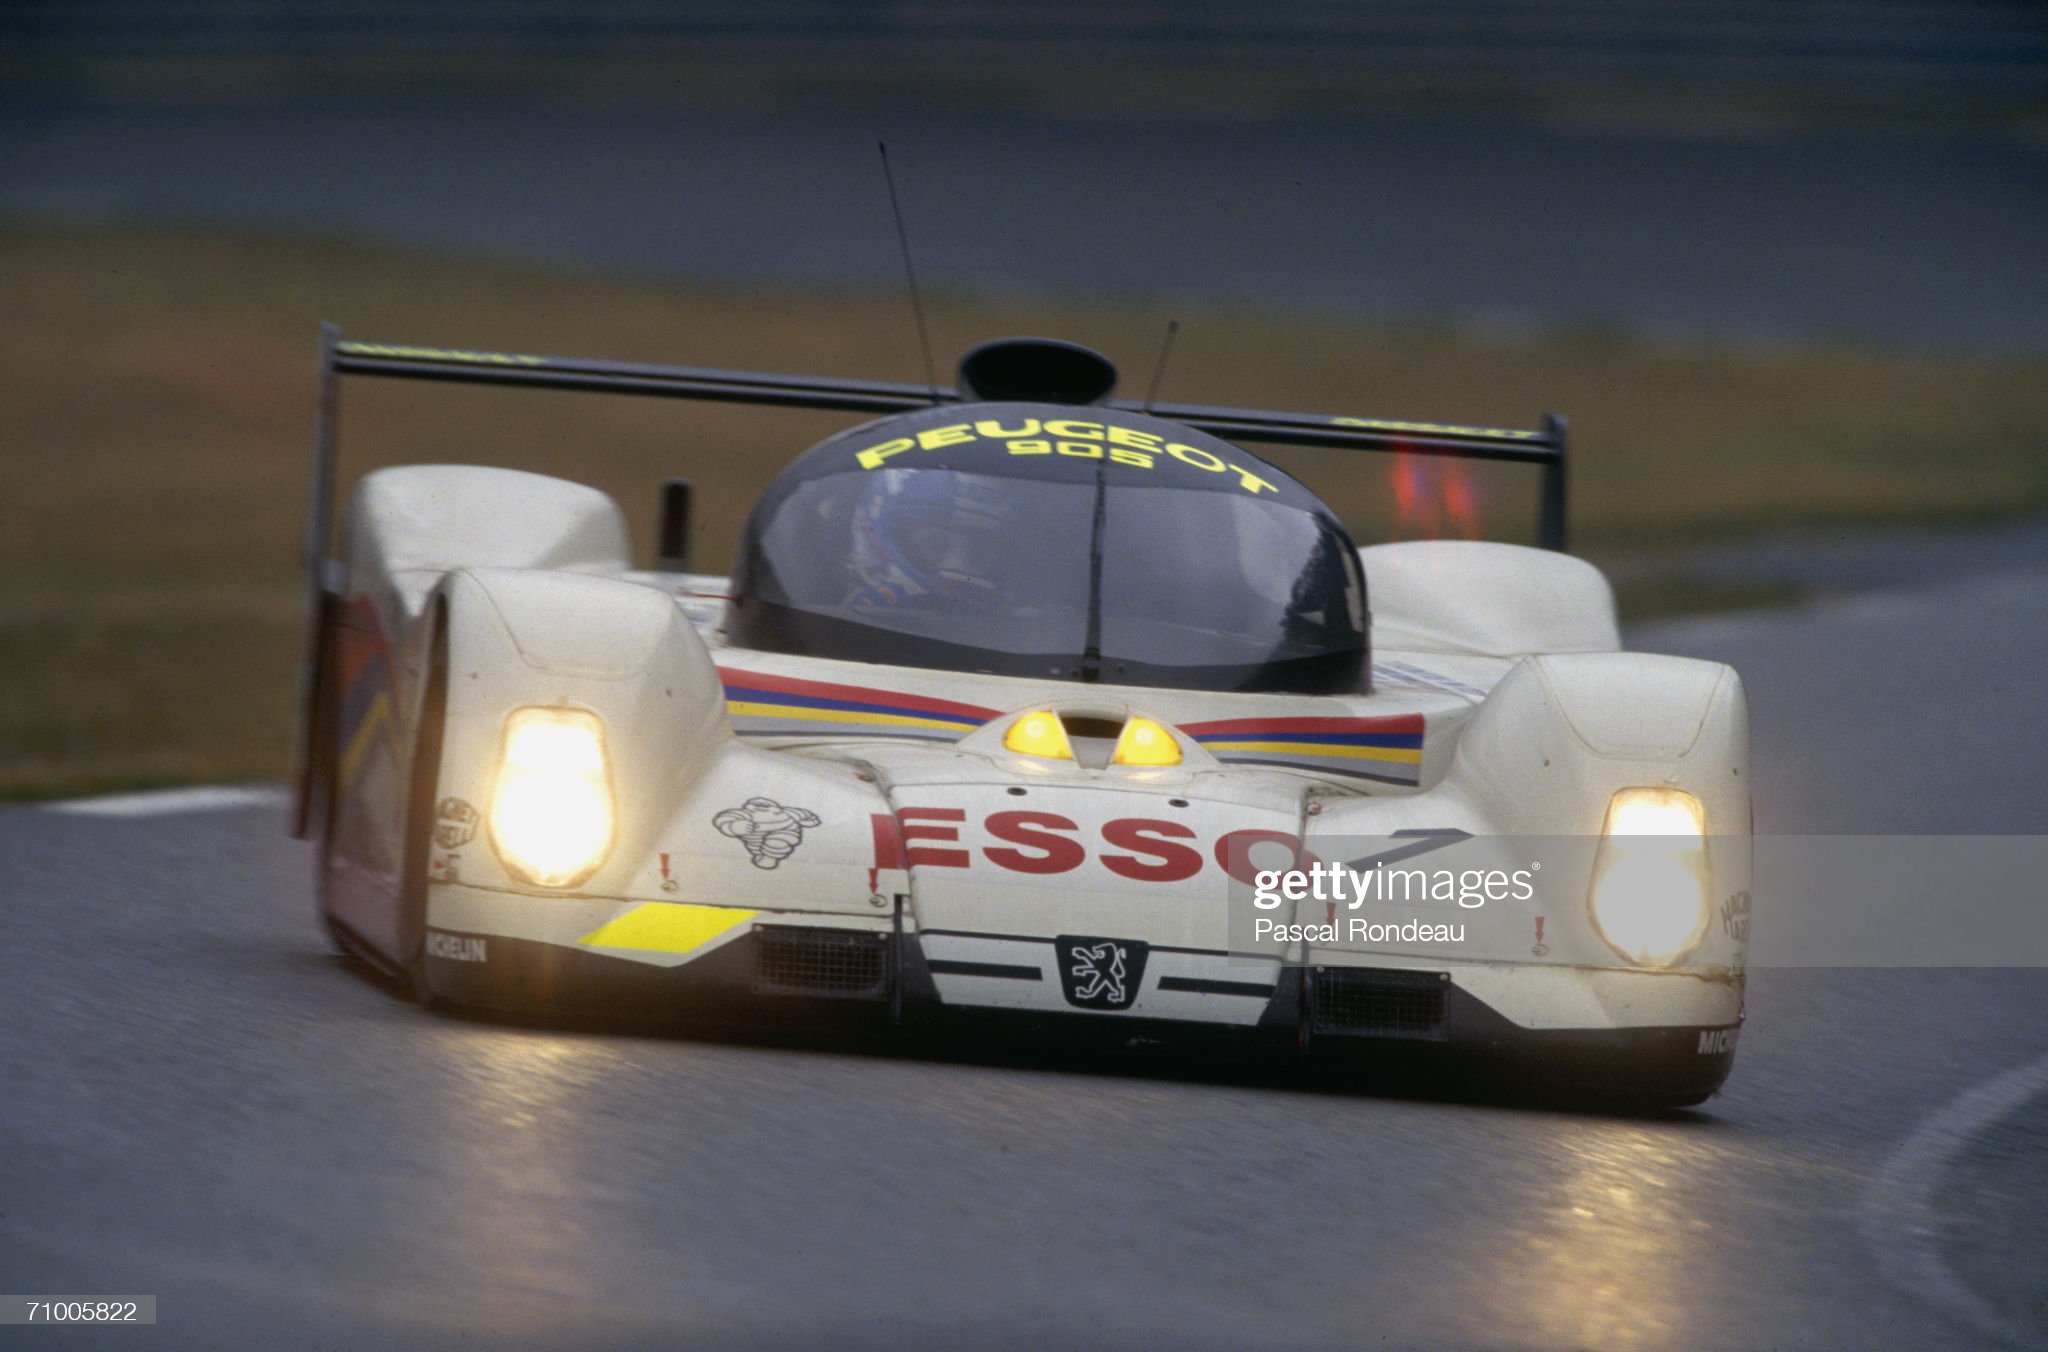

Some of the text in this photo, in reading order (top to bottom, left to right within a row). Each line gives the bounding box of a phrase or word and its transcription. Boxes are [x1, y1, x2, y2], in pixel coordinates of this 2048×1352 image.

[855, 418, 1280, 495] PEUGEOT
[1005, 440, 1155, 469] 905
[870, 806, 1324, 893] ESSO
[425, 931, 488, 963] ICHELIN
